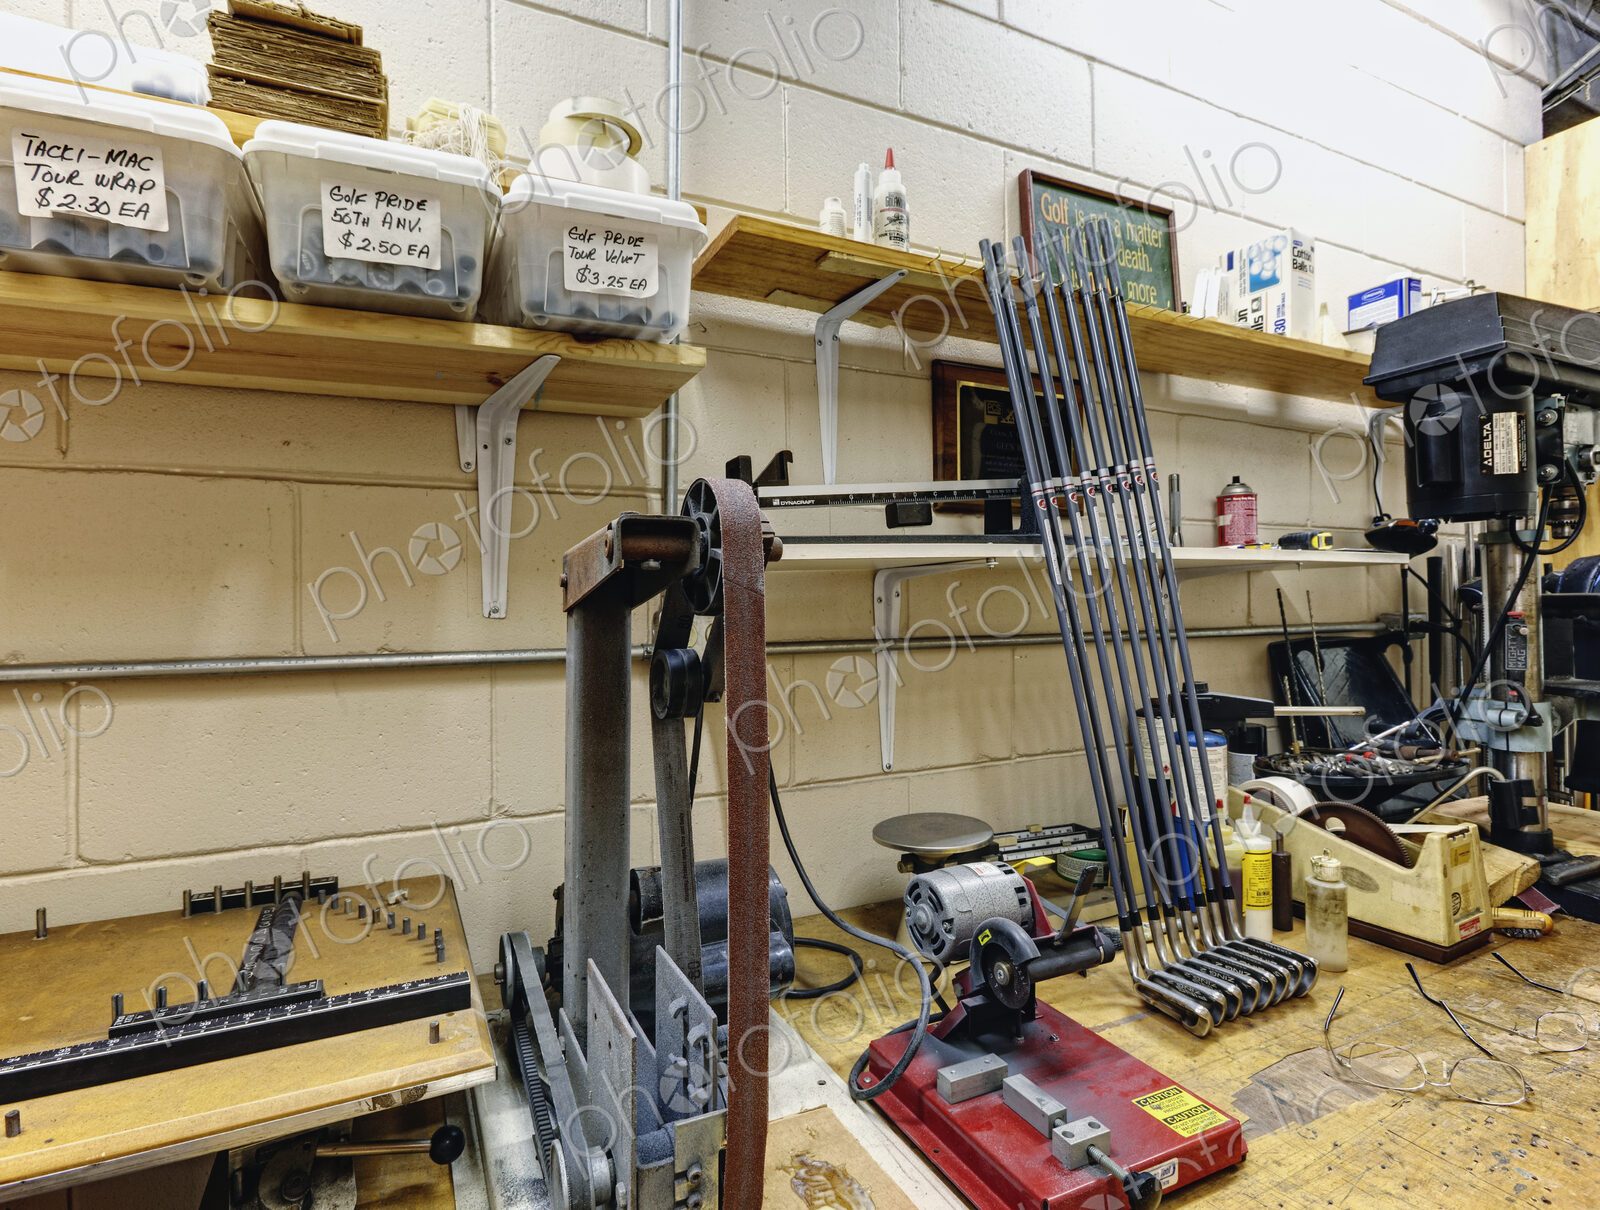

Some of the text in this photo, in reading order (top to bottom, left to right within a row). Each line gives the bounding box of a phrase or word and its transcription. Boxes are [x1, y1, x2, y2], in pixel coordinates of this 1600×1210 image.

[24, 163, 156, 194] TOUR WRAP
[118, 201, 150, 221] EA
[375, 191, 428, 211] PRIDE
[1040, 192, 1069, 226] Golf
[1114, 219, 1122, 238] a
[1126, 222, 1163, 249] matter
[407, 244, 430, 259] EA
[629, 278, 648, 291] EA
[1126, 280, 1158, 305] more
[1483, 422, 1492, 458] DELTA
[1508, 634, 1517, 668] MIGHTY
[1517, 649, 1526, 668] MAG
[1140, 1088, 1180, 1106] CAUTION
[1167, 1105, 1207, 1124] CAUTION
